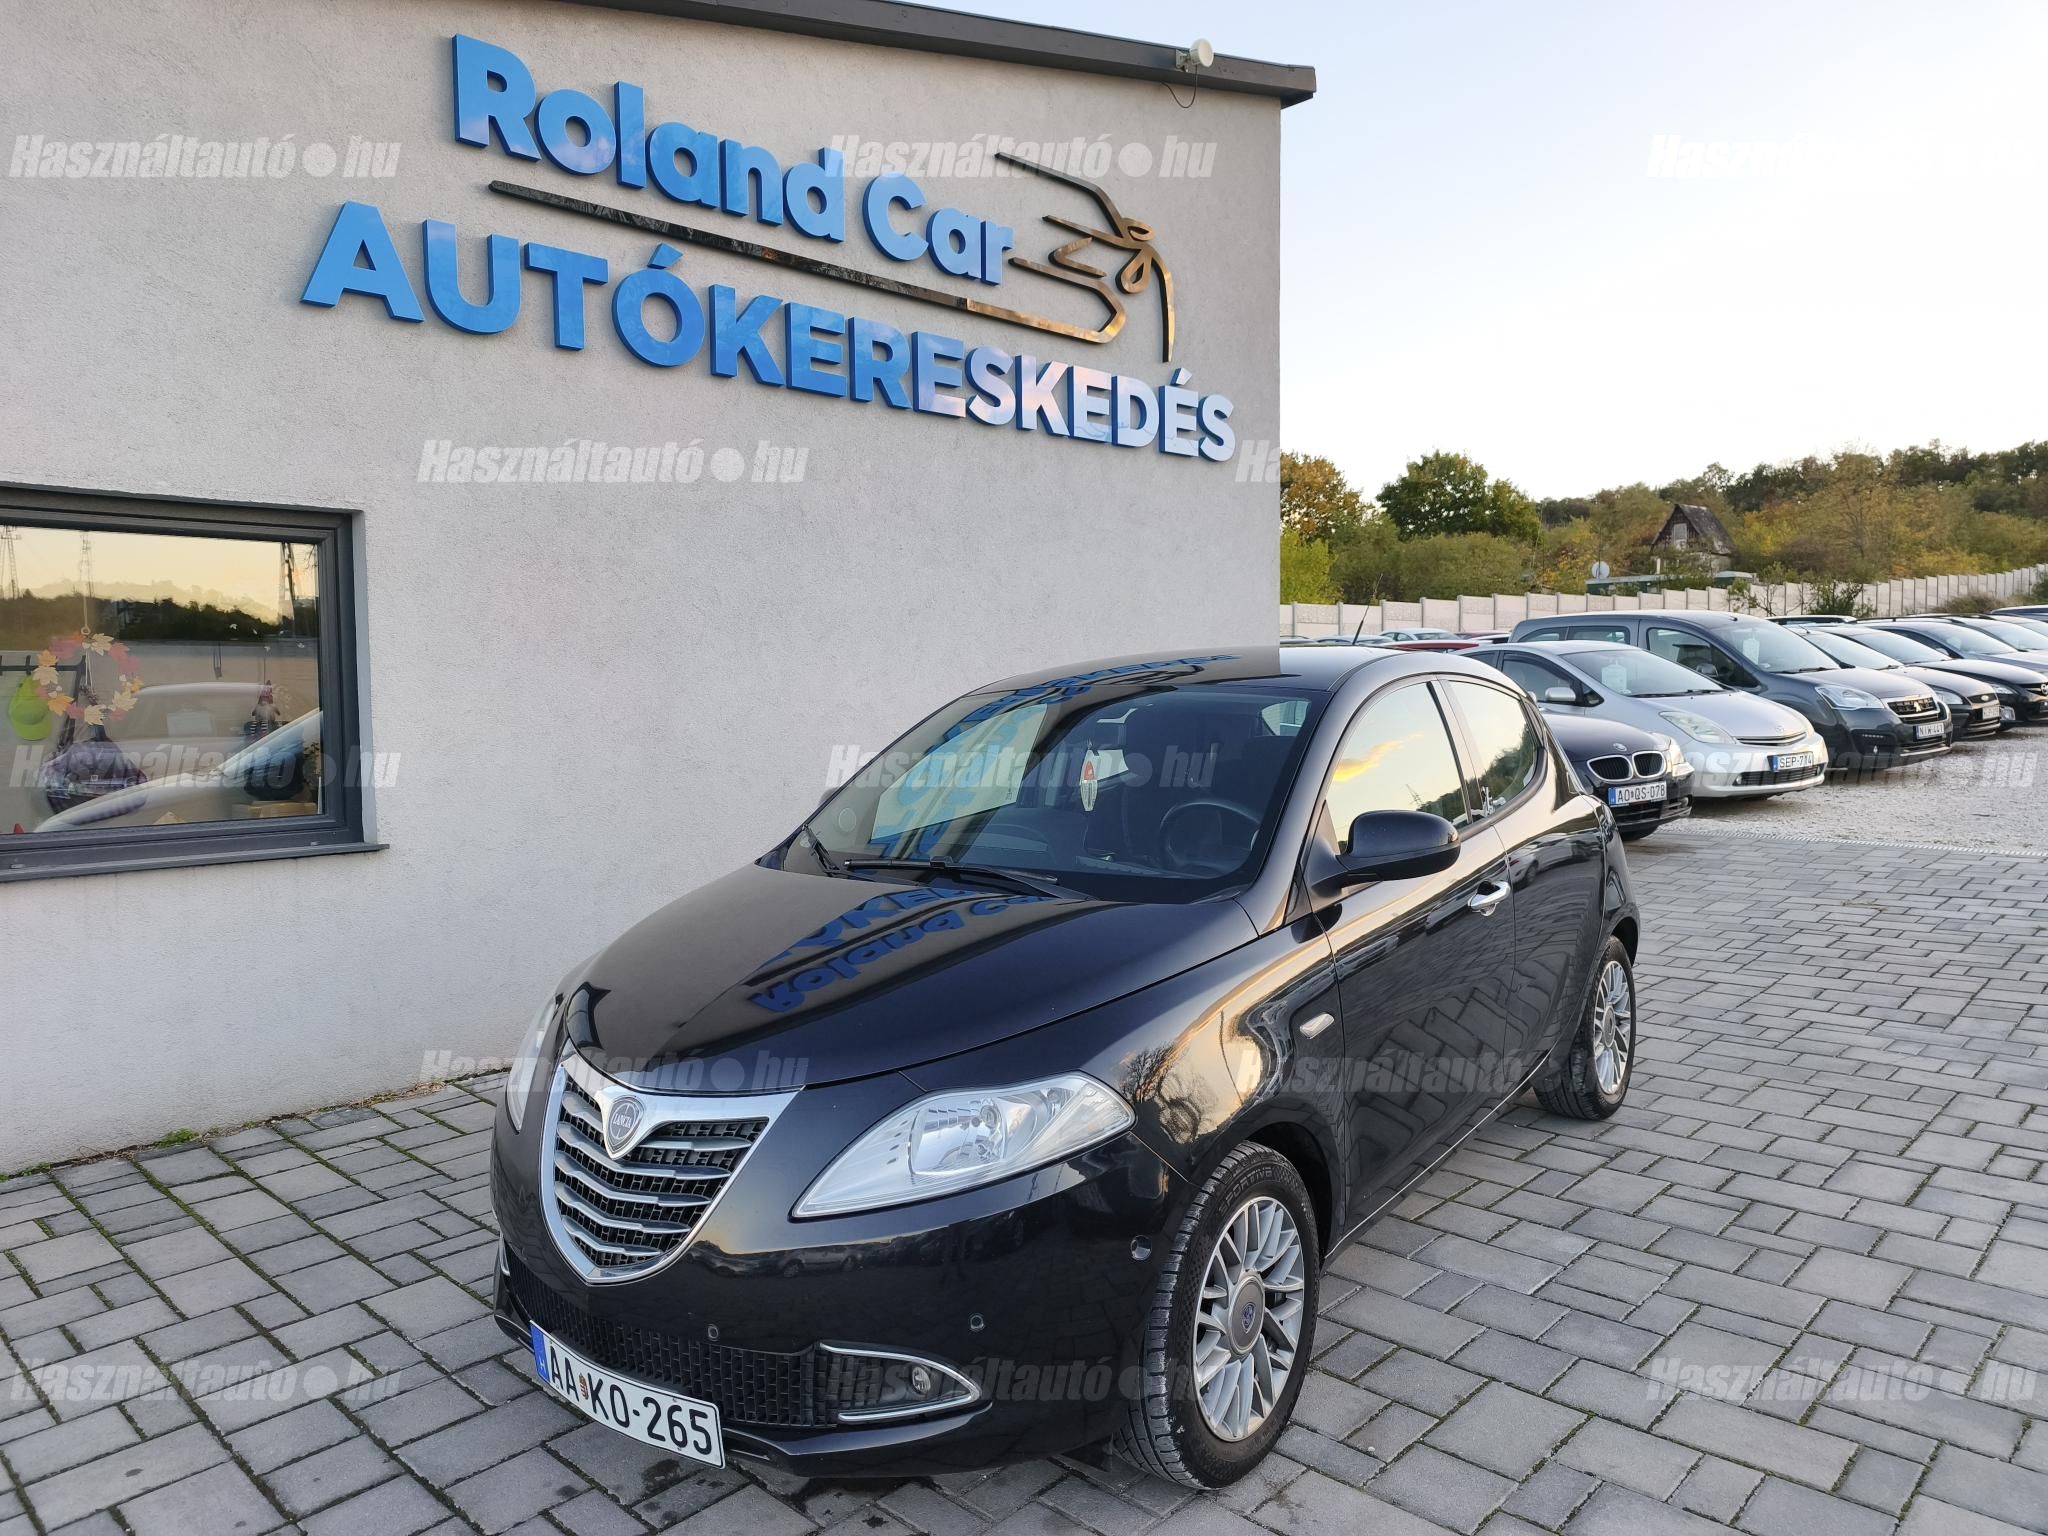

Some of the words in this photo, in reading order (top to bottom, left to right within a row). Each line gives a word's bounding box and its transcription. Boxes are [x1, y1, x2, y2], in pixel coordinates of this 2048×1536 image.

[452, 34, 846, 243] Roland
[862, 172, 1014, 286] Car
[301, 201, 1235, 462] AUTÓKERESKEDÉS
